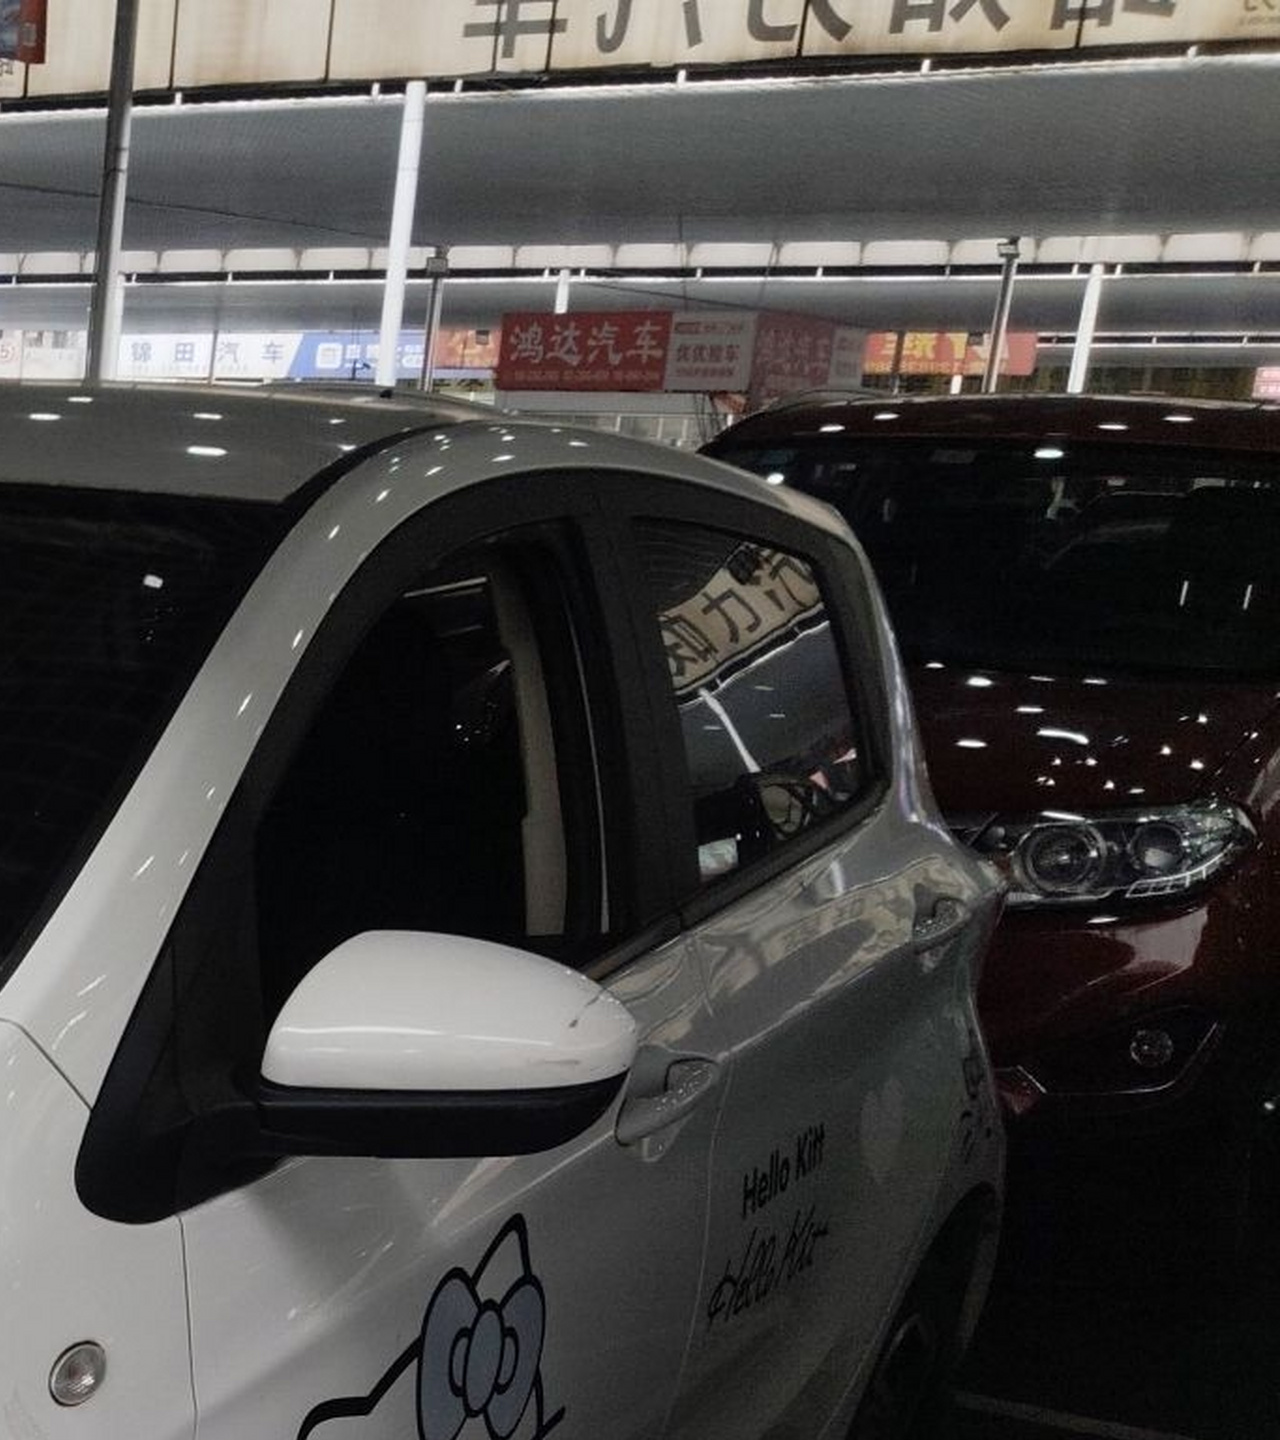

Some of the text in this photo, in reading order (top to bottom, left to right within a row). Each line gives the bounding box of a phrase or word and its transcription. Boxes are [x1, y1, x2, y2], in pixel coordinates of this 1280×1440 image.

[509, 320, 665, 366] 鸿达汽车
[741, 1149, 791, 1219] Hello
